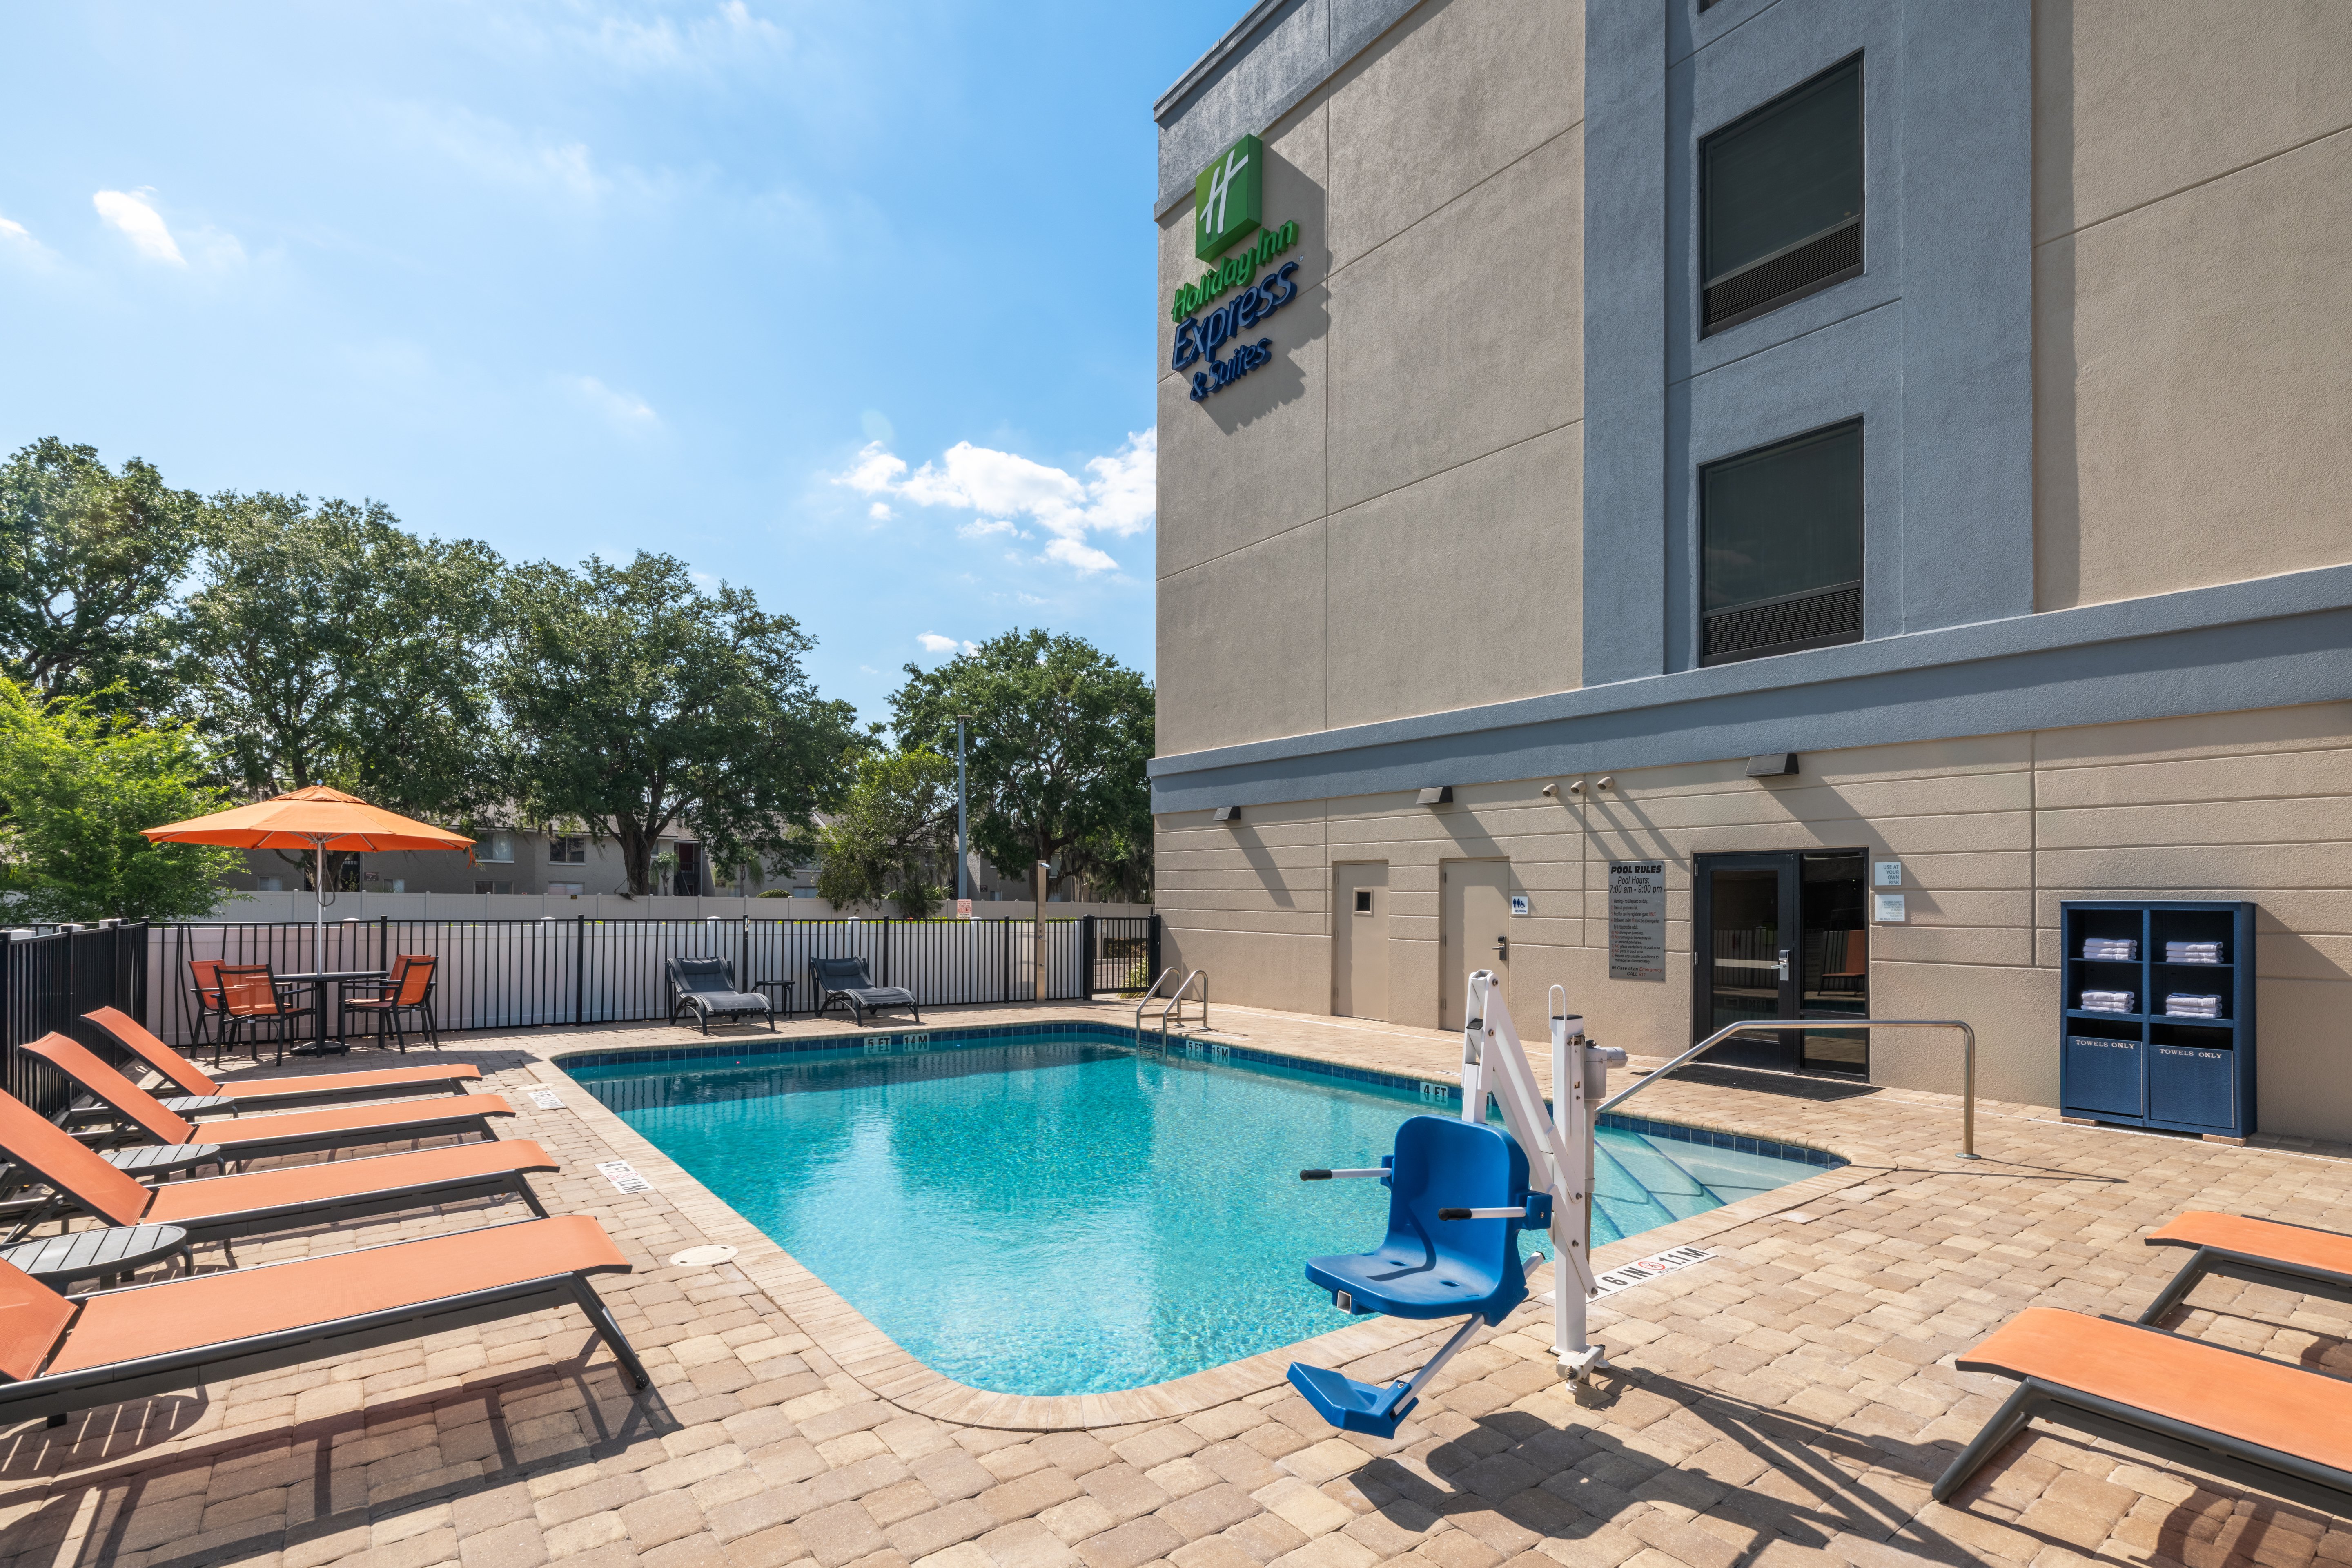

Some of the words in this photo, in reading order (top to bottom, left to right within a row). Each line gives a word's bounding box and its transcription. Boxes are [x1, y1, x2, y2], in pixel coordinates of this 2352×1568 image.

[1171, 247, 1256, 323] Holiday
[1256, 220, 1299, 267] Inn
[1172, 261, 1299, 372] Express
[1189, 371, 1208, 403] &
[1207, 338, 1273, 394] Suites
[1635, 865, 1662, 873] RULES
[1618, 876, 1630, 884] Pool
[1632, 876, 1650, 884] Hours:
[1638, 885, 1651, 893] 9:00
[1653, 886, 1662, 895] pm
[878, 1038, 890, 1046] FT
[919, 1035, 928, 1043] M
[1195, 1043, 1203, 1051] FT
[1221, 1048, 1228, 1056] M
[1424, 1085, 1430, 1094] 4
[1434, 1086, 1446, 1097] FT
[1601, 1276, 1628, 1285] 6
[1616, 1267, 1654, 1280] IN
